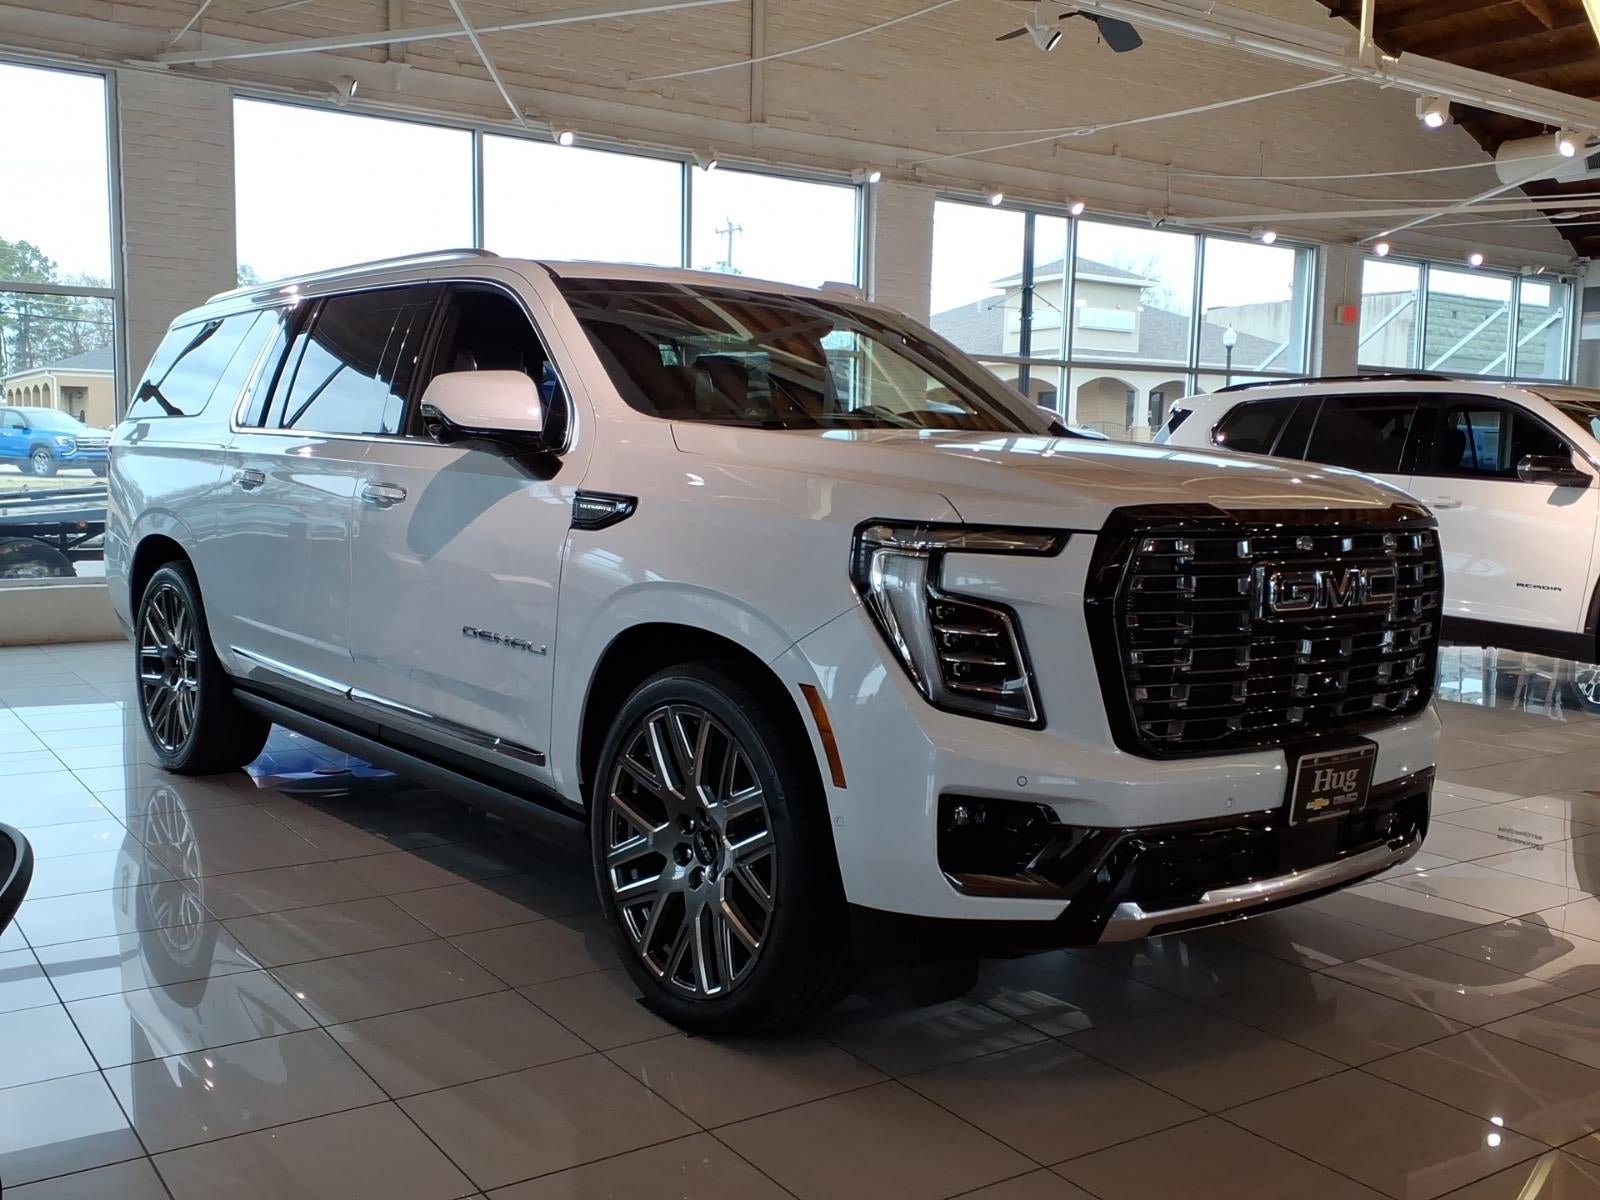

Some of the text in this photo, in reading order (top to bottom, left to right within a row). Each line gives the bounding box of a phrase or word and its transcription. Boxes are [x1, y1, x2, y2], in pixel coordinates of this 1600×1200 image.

[1269, 568, 1397, 611] GMC
[1516, 583, 1562, 592] ACADIA
[462, 626, 547, 656] DENALI
[1311, 768, 1360, 793] Hug
